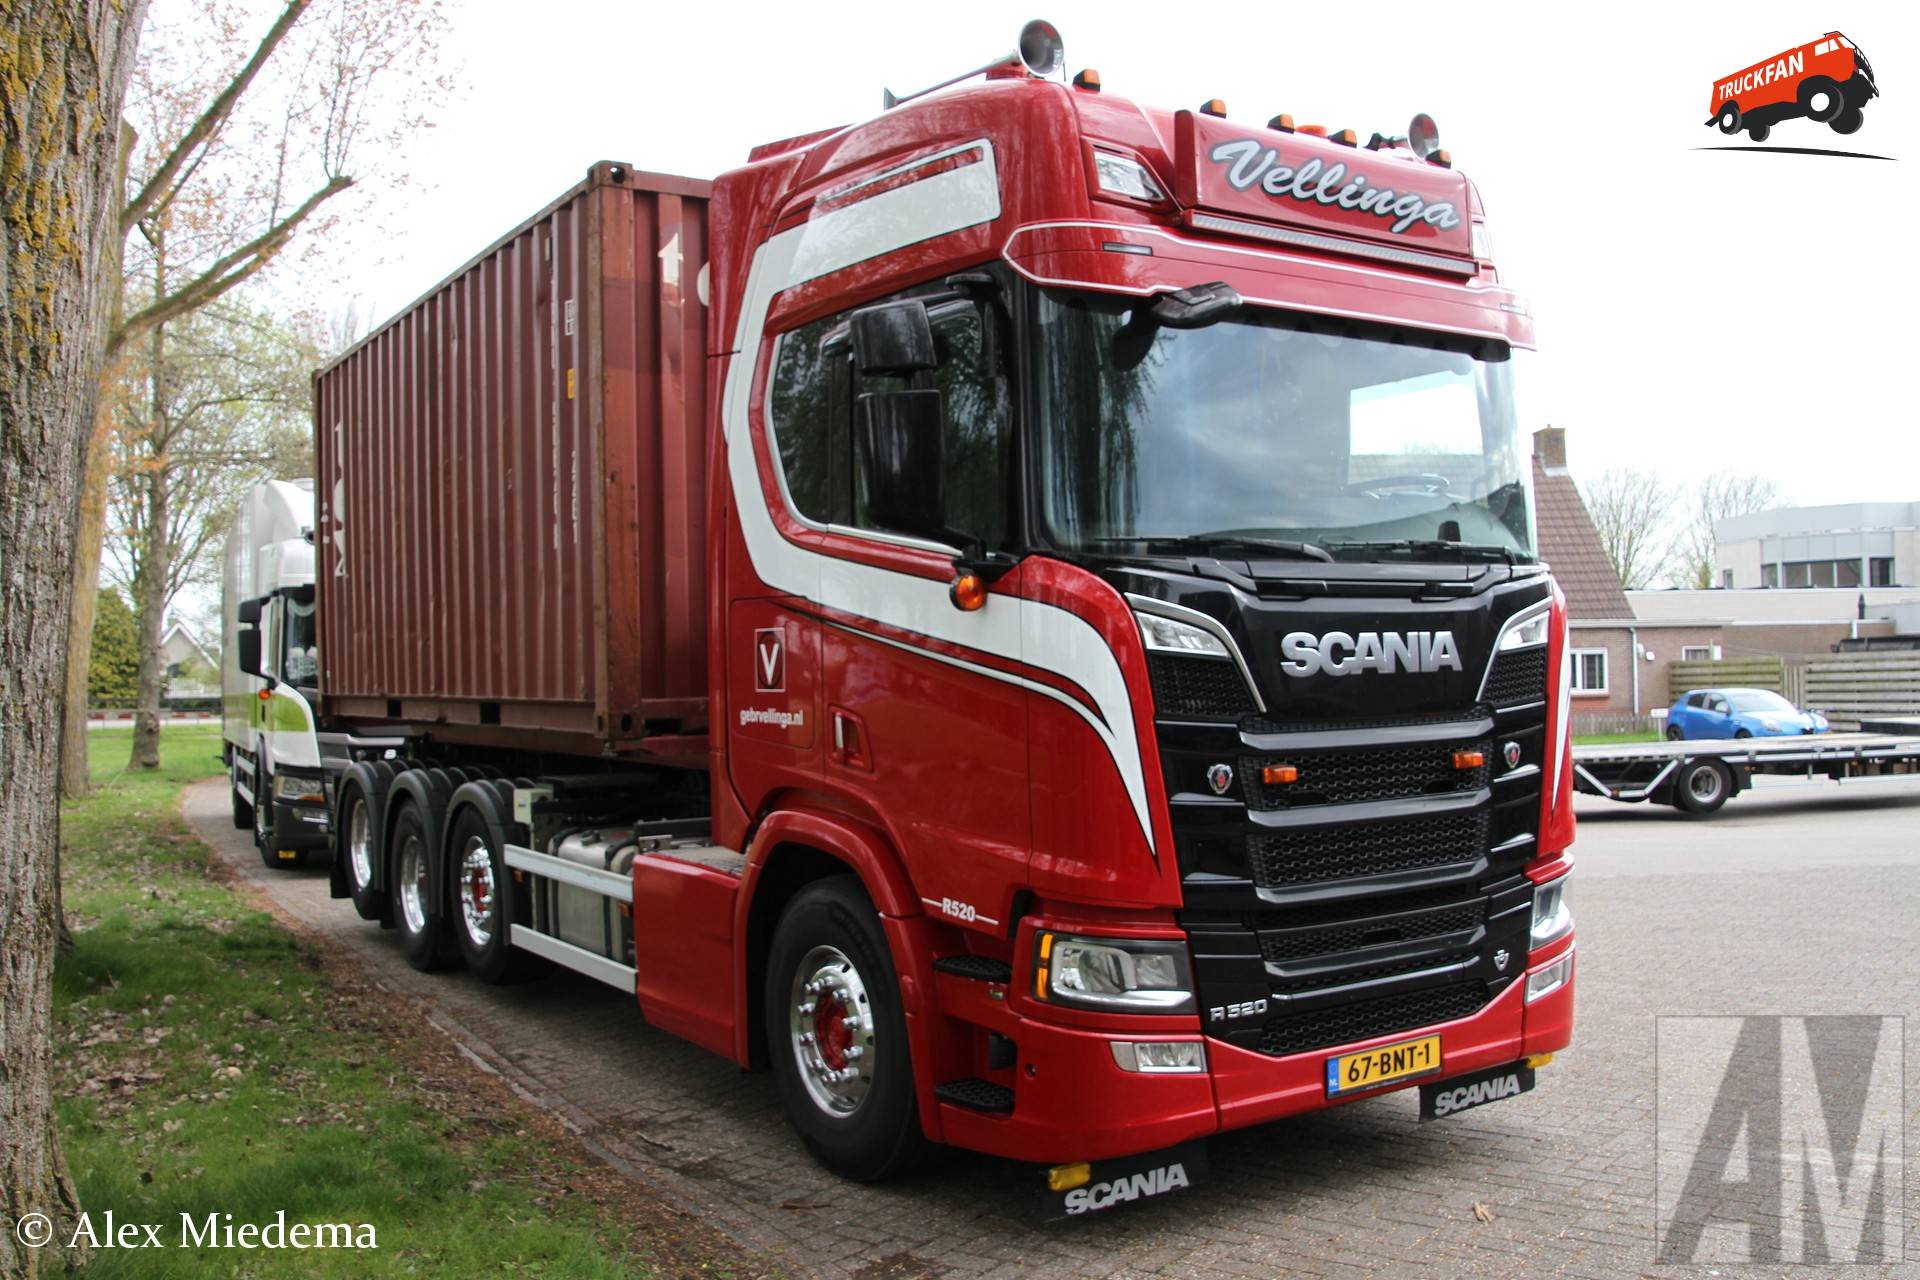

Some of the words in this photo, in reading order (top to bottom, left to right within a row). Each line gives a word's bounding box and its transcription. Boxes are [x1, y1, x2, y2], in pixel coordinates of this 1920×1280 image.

[1211, 138, 1461, 235] Vellinga
[759, 643, 780, 686] V
[1280, 631, 1463, 678] SCANIA
[942, 897, 975, 922] R520
[1348, 1042, 1431, 1083] 67-BNT-1
[1434, 1074, 1521, 1116] SCANIA
[1064, 1163, 1190, 1215] SCANIA
